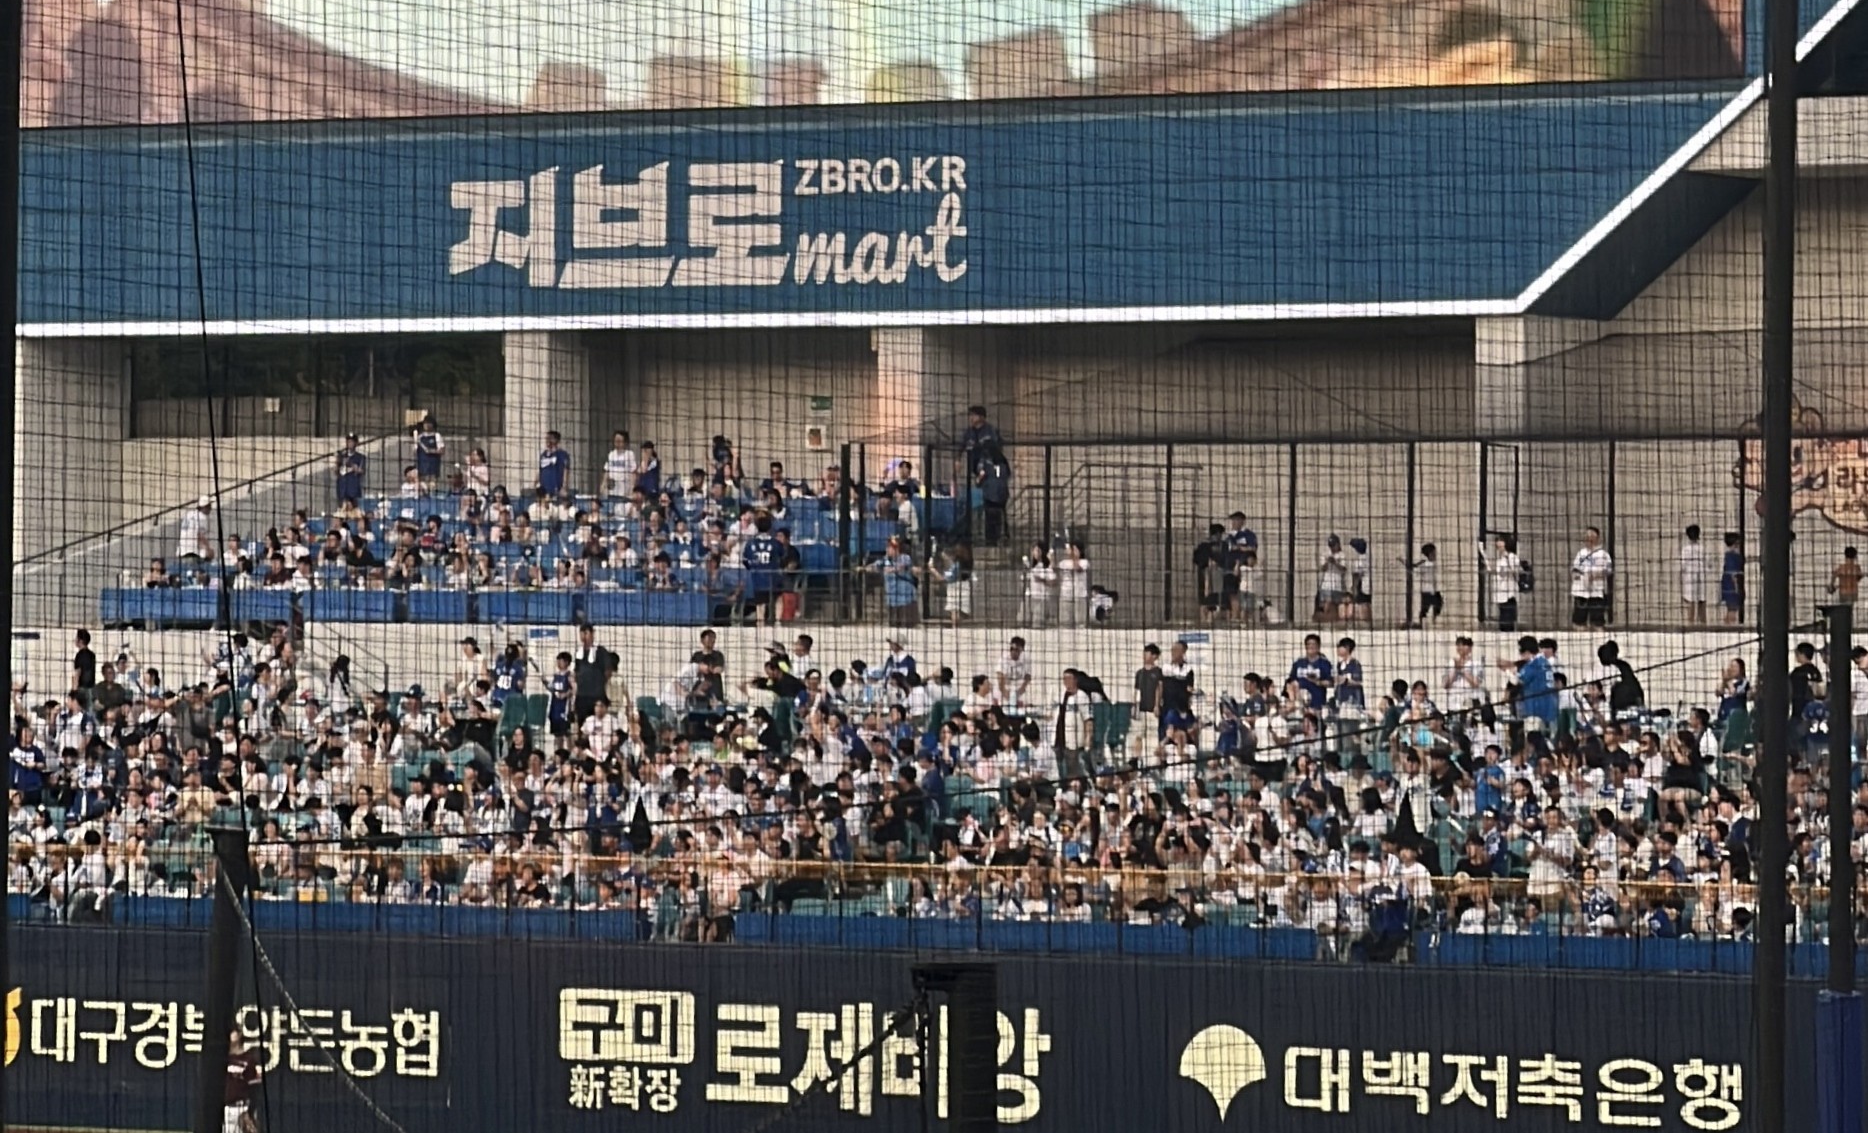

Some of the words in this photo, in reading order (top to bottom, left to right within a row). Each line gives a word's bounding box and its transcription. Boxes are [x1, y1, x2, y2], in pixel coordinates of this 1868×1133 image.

[795, 156, 967, 195] ZBRO.KR
[449, 161, 790, 288] 지브로
[794, 192, 968, 285] mart
[569, 1064, 681, 1112] 新확장
[1283, 1045, 1743, 1131] 대백저축은행
